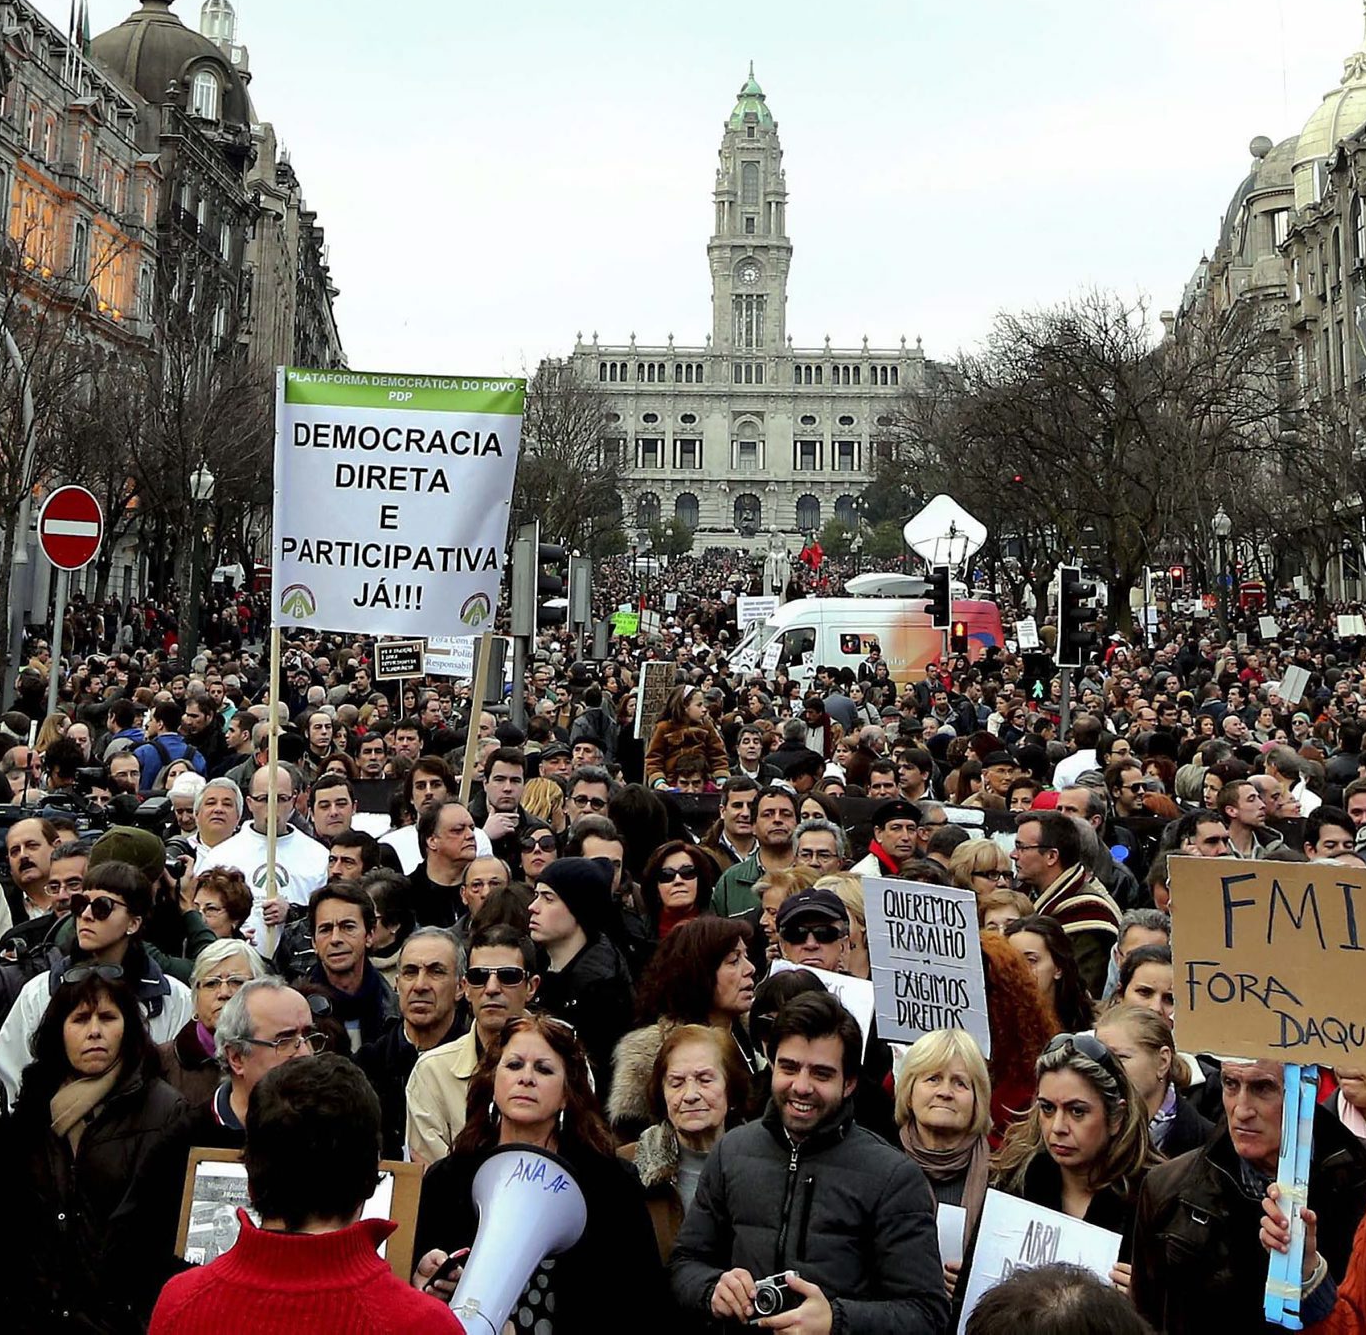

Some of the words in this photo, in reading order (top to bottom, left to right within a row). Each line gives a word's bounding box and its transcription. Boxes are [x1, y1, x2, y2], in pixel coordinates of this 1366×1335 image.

[288, 372, 368, 386] PLATAFORMA
[371, 376, 459, 390] DEMOCRÁTICA
[461, 380, 479, 391] DO
[482, 381, 517, 393] POVO
[388, 391, 413, 402] PDP
[293, 422, 504, 458] DEMOCRACIA
[335, 463, 451, 494] DIRETA
[379, 504, 399, 530] E
[281, 537, 498, 572] PARTICIPATIVA
[352, 577, 423, 611] JÁ!!!
[883, 889, 967, 930] QUEREMOS
[1221, 872, 1366, 951] FMI
[884, 919, 966, 960] TRABALHO
[894, 969, 970, 1010] EXIGIMOS
[1185, 961, 1303, 1012] FORA
[895, 999, 965, 1033] DIREITOS
[505, 1157, 547, 1187] ANA
